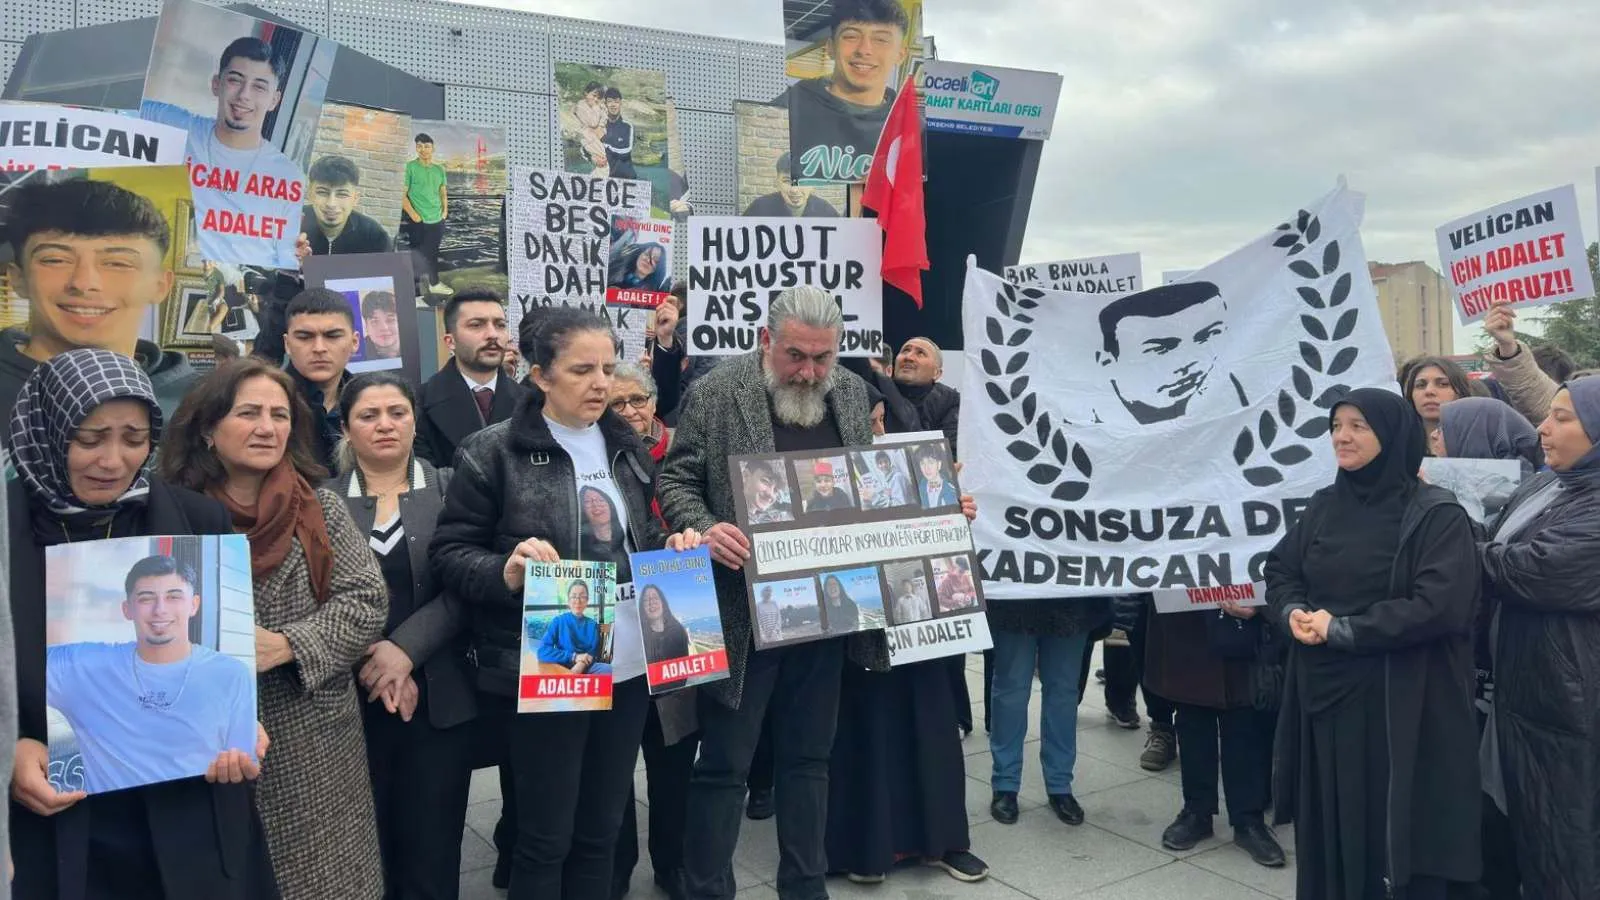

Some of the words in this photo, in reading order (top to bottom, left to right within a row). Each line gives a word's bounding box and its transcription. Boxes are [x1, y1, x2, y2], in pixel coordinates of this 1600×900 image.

[924, 72, 970, 92] ocaeli
[958, 98, 1012, 115] KARTLARI
[244, 173, 302, 203] ARAS
[529, 171, 637, 209] SADECE
[203, 208, 288, 241] ADALET
[1449, 201, 1554, 251] VELİCAN
[701, 224, 837, 262] HUDUT
[1049, 262, 1109, 281] BAVULA
[1450, 255, 1482, 288] İÇİN
[1486, 233, 1565, 275] ADALET
[688, 260, 864, 292] NAMUSTUR
[1076, 276, 1137, 294] ADALET
[616, 291, 654, 304] ADALET
[1004, 504, 1231, 543] SONSUZA
[976, 548, 1232, 588] KADEMCAN
[1186, 583, 1255, 605] YANMASIN
[917, 618, 973, 647] ADALET
[661, 657, 706, 680] ADALET
[537, 678, 590, 695] ADALET
